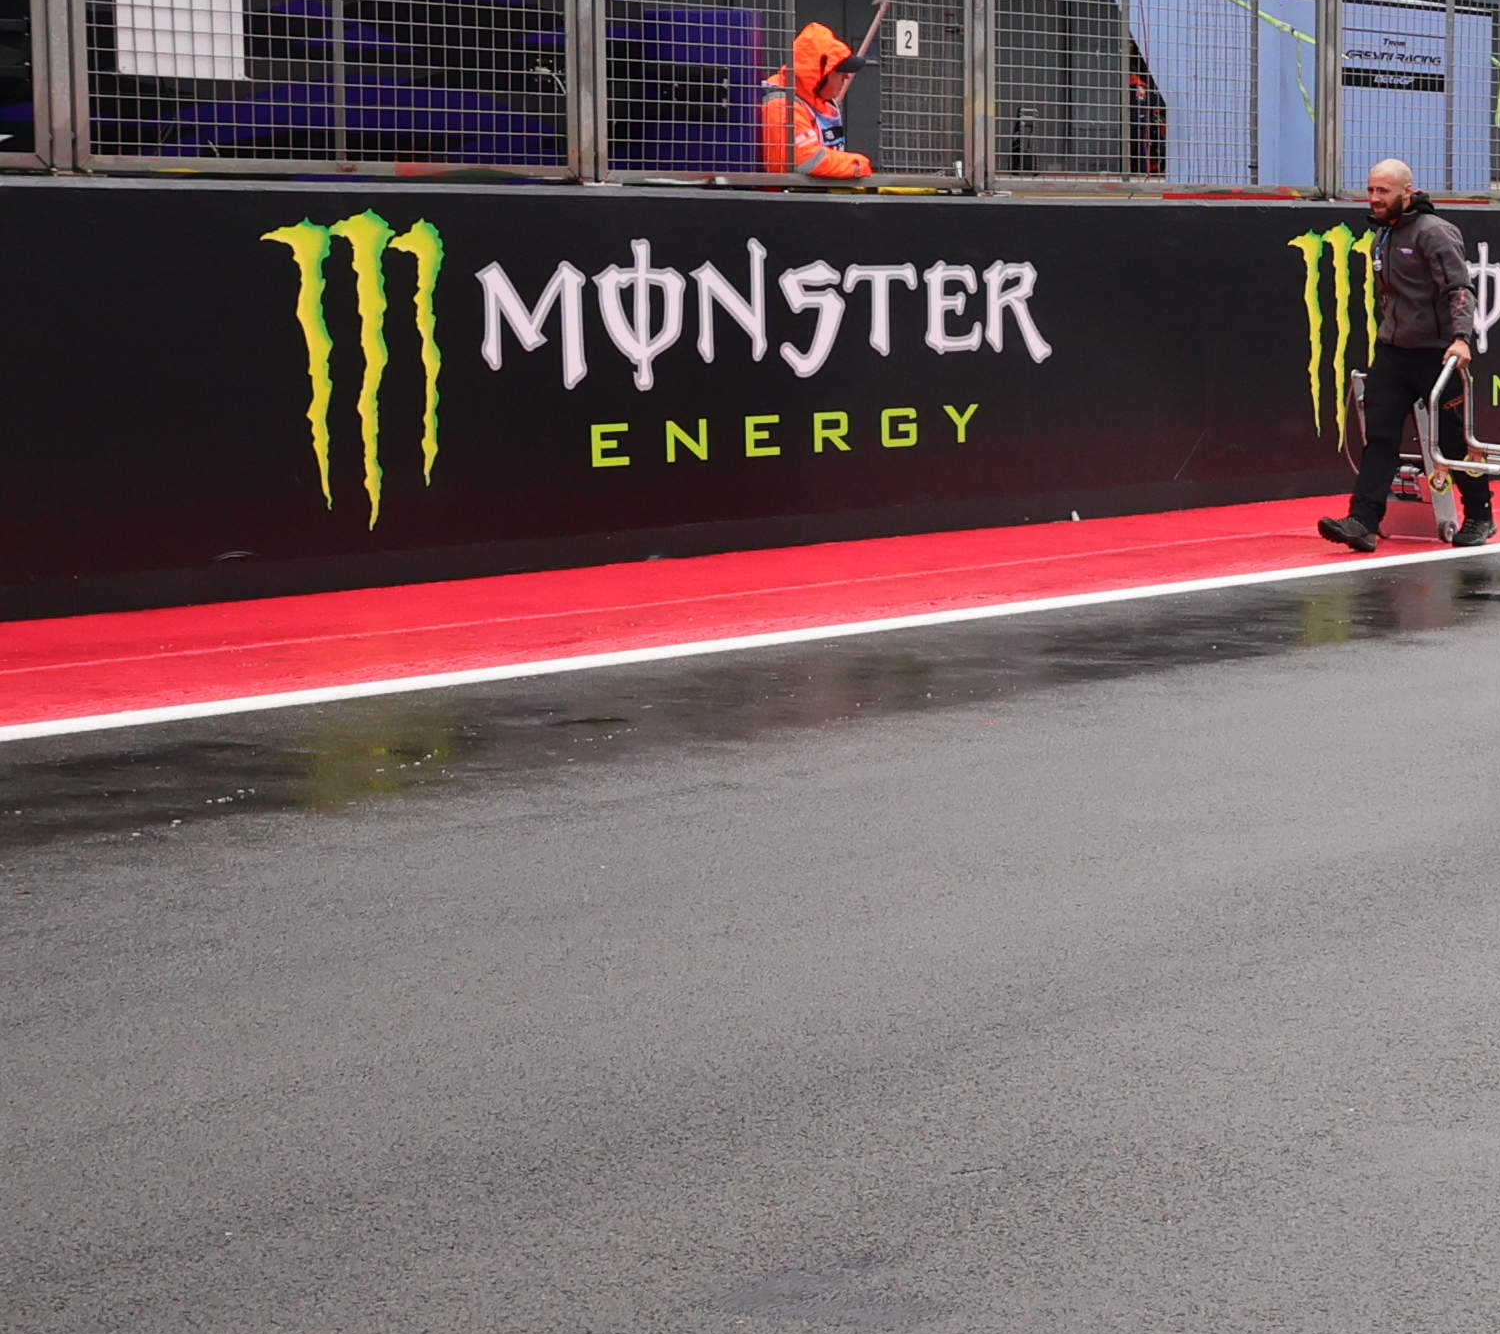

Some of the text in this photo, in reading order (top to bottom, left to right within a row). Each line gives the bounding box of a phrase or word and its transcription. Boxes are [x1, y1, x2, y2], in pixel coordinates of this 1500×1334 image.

[903, 30, 913, 50] 2
[474, 237, 1053, 392] MONSTER
[591, 403, 980, 469] ENERGY
